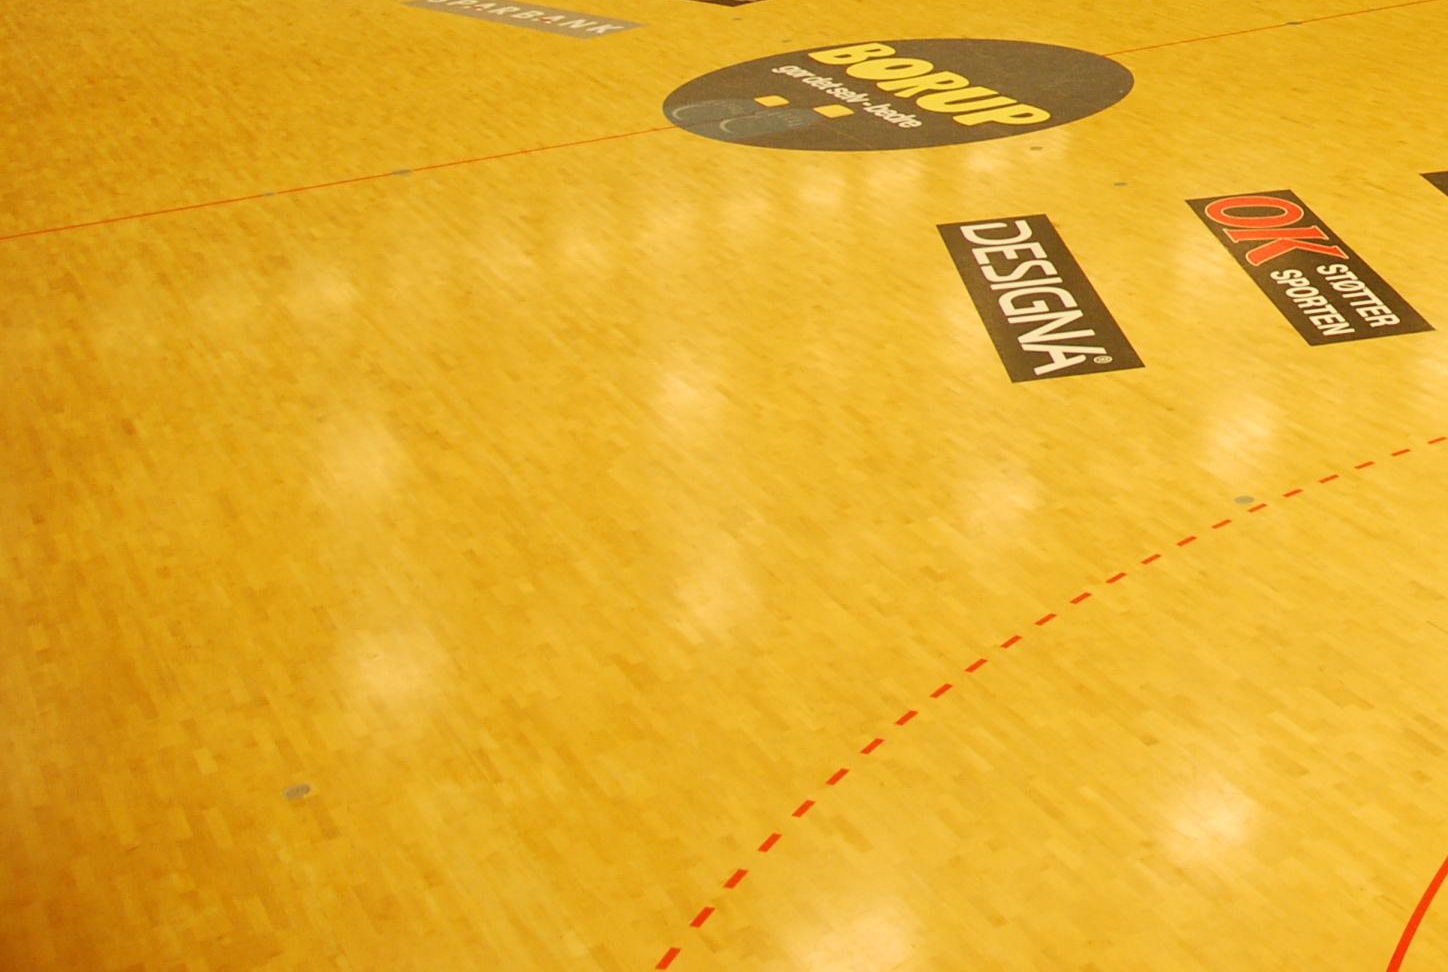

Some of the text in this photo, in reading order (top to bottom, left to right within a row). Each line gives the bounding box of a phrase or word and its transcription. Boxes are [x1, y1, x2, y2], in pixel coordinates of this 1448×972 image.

[808, 43, 1051, 126] BORUP
[1205, 195, 1350, 267] OK
[1270, 268, 1356, 337] SPORTEN
[1316, 263, 1401, 329] STØTTER
